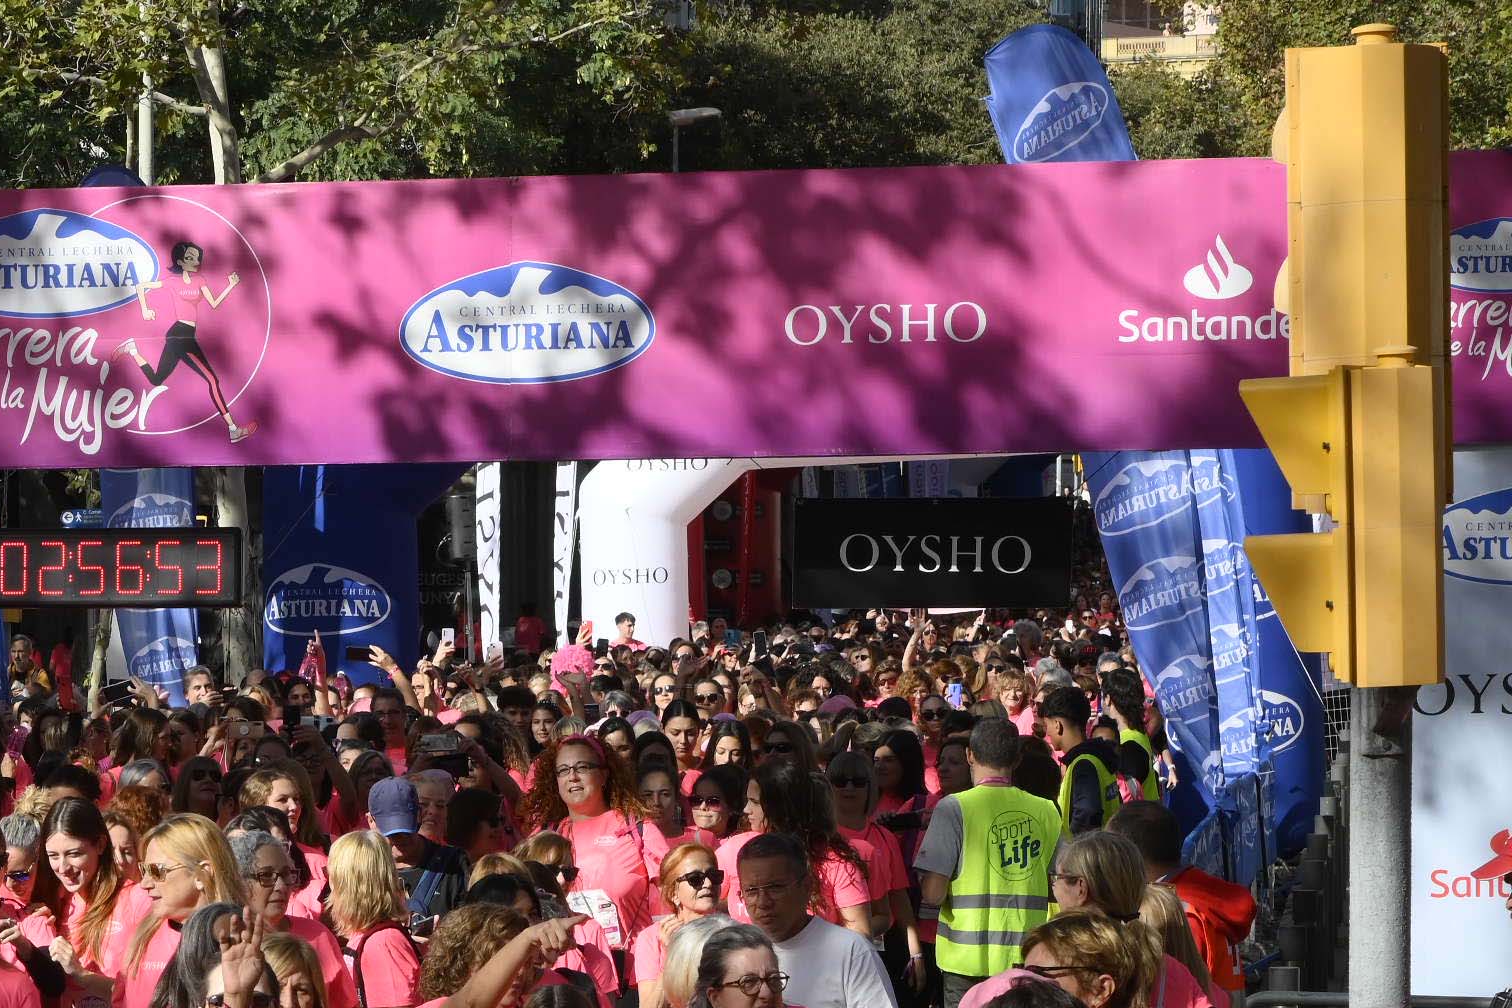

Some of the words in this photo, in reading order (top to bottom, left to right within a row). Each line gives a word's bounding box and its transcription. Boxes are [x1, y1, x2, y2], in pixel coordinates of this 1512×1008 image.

[63, 245, 134, 256] LECHERA
[459, 304, 536, 316] CENTRAL
[547, 303, 626, 315] LECHERA
[786, 301, 986, 345] OYSHO
[420, 308, 635, 353] ASTURIANA
[1468, 329, 1487, 356] la
[1, 369, 24, 409] la
[20, 361, 169, 454] Mujer
[0, 538, 224, 598] 02:56:53
[839, 533, 1032, 574] OYSHO
[593, 566, 668, 585] OYSHO
[269, 592, 381, 621] ASTURIANA
[991, 817, 1034, 845] Sport
[999, 835, 1041, 868] Life
